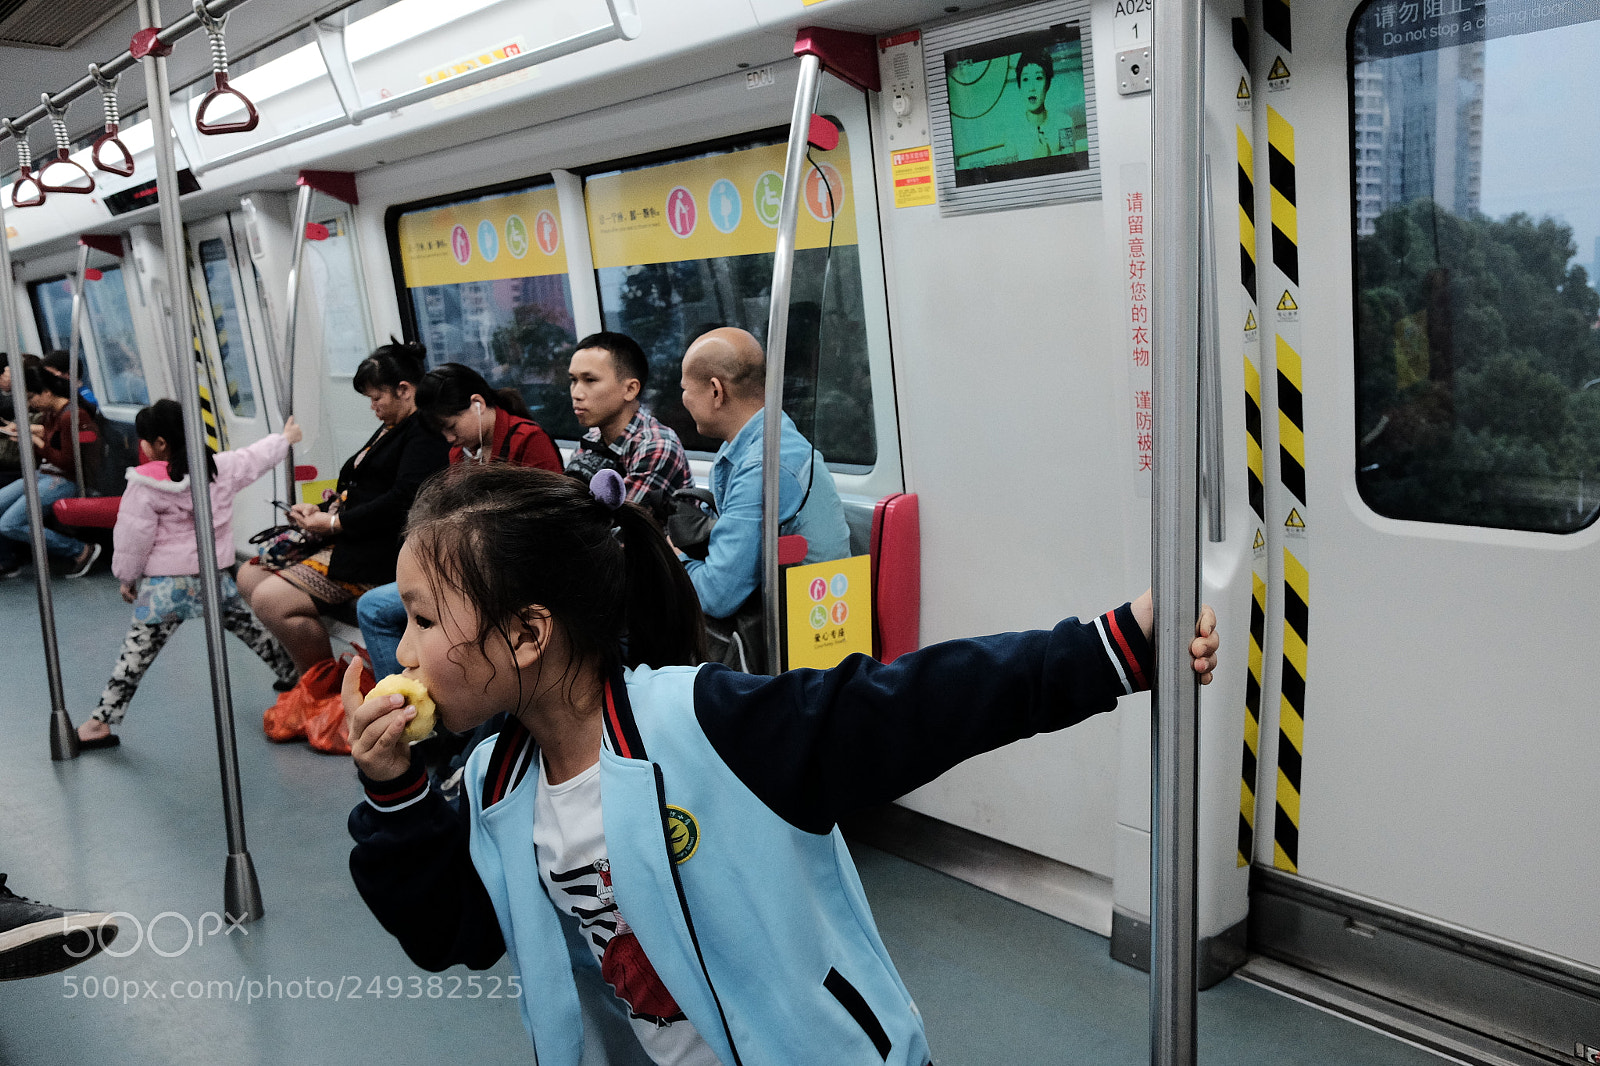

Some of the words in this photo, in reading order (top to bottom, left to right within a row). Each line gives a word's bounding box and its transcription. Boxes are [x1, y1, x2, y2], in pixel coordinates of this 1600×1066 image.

[1132, 23, 1138, 39] 1
[1374, 0, 1497, 29] 请勿阻止
[1383, 31, 1402, 46] Do
[1405, 26, 1427, 42] not
[1430, 22, 1460, 38] stop
[1463, 20, 1472, 32] a
[1476, 8, 1527, 29] closing
[1126, 191, 1150, 367] 请留意好您的衣物
[1134, 390, 1152, 472] 谨防被夹
